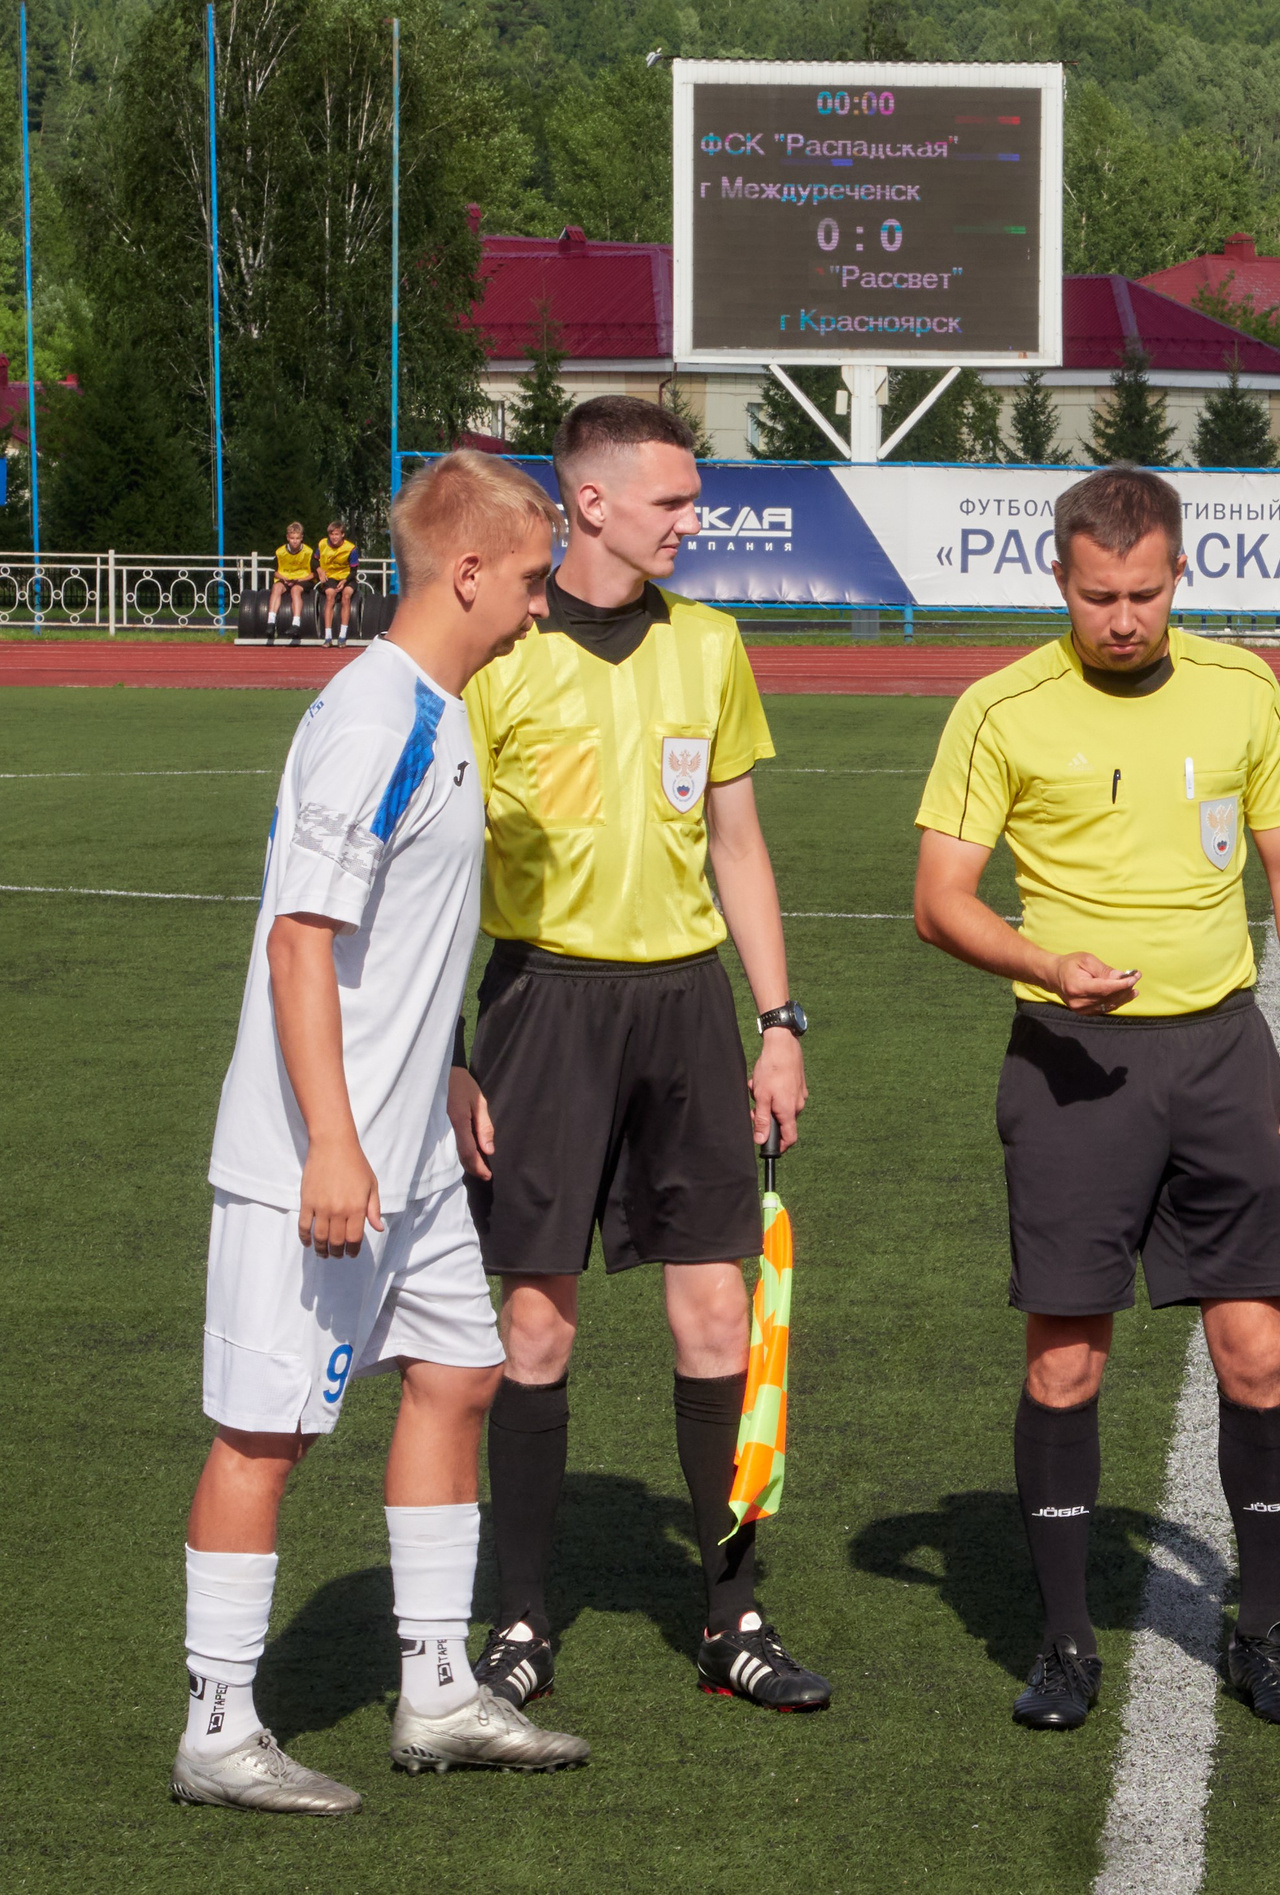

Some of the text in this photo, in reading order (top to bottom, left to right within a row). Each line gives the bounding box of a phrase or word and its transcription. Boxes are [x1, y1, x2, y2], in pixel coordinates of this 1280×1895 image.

[817, 91, 895, 115] 00:00
[700, 132, 765, 156] ФСК
[700, 176, 922, 206] г Междуреченск
[829, 265, 963, 289] "Рассвет"
[780, 309, 962, 337] г Красноярск
[688, 541, 792, 552] МПАНИЯ
[323, 1343, 353, 1404] 9
[1031, 1505, 1090, 1518] JÖGEL
